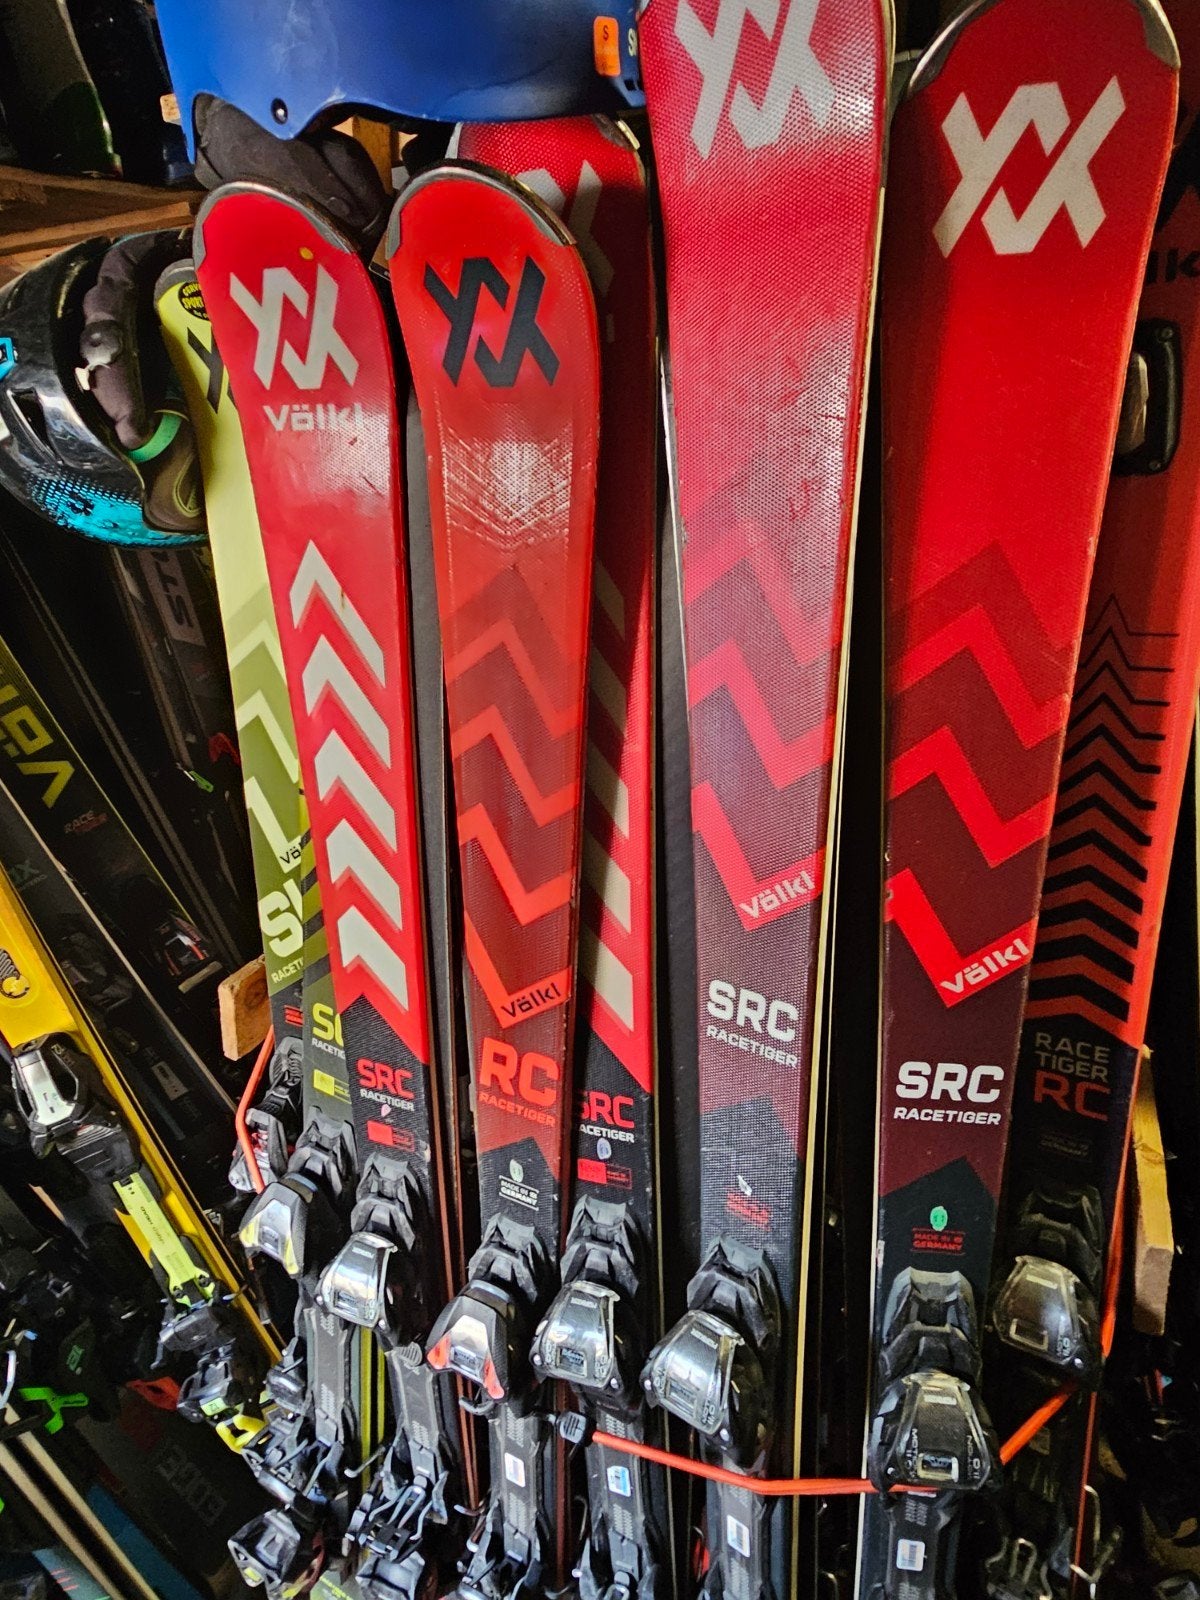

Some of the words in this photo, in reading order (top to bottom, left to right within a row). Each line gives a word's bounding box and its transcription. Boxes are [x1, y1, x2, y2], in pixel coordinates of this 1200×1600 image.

[262, 402, 364, 432] Völkl
[739, 870, 816, 920] Völkl
[940, 937, 1031, 995] Völkl
[500, 982, 562, 1019] Völkl
[706, 978, 799, 1043] SRC
[706, 1024, 799, 1068] RACETIGER
[1035, 1031, 1111, 1064] RACE
[356, 1057, 415, 1100] SRC
[479, 1036, 560, 1107] RC
[895, 1060, 1006, 1104] SRC
[1034, 1050, 1109, 1084] TIGER
[359, 1087, 415, 1113] RACETIGER
[478, 1090, 556, 1128] RACETIGER
[1033, 1069, 1112, 1123] RC
[579, 1123, 636, 1144] ACETIGER
[893, 1106, 1002, 1126] RACETIGER
[913, 1240, 963, 1251] GERMANY
